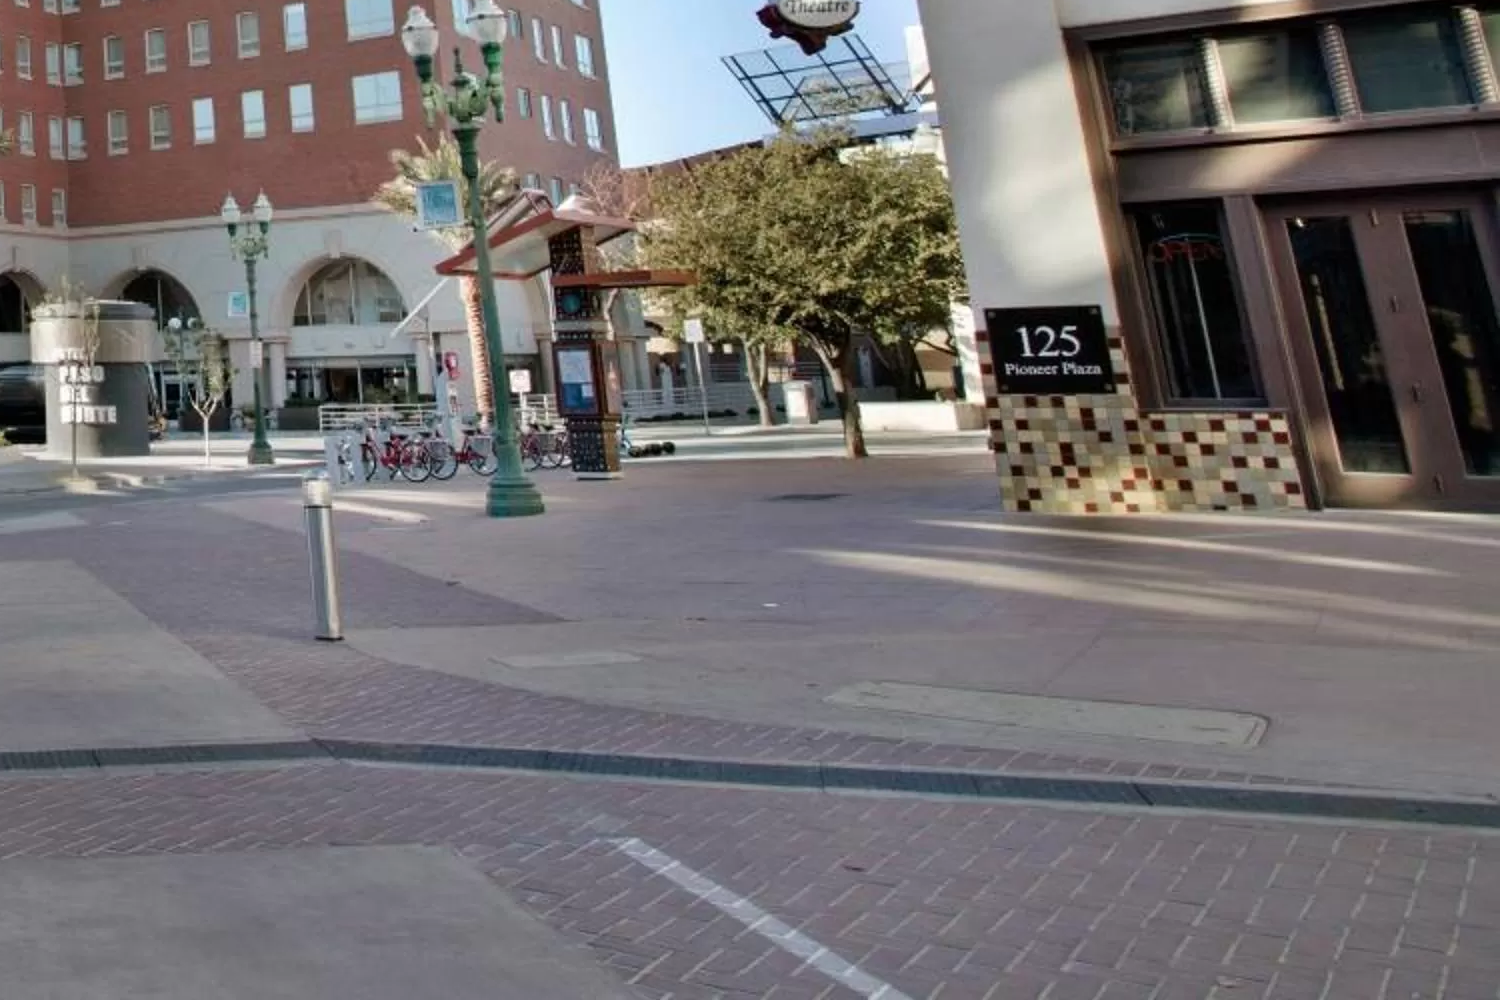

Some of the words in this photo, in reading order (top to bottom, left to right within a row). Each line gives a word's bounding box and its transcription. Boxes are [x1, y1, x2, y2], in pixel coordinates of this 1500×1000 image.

[1016, 325, 1081, 357] 125
[1004, 362, 1057, 376] Pioneer
[1062, 361, 1102, 375] Plaza
